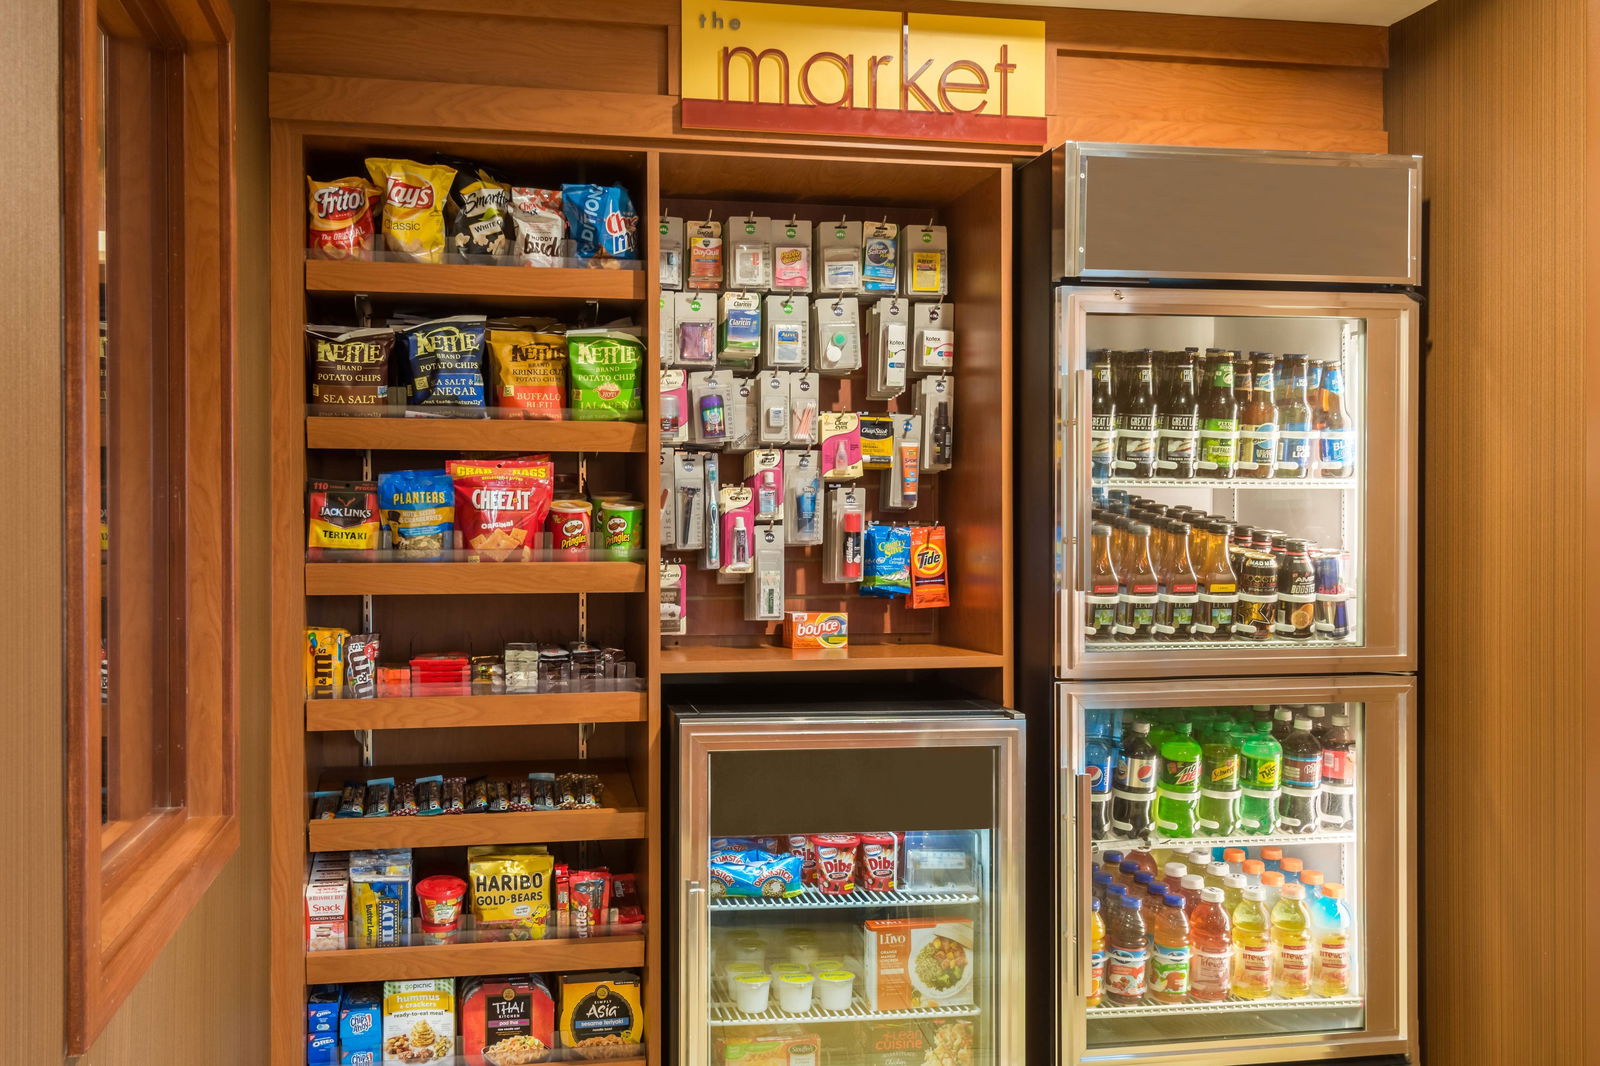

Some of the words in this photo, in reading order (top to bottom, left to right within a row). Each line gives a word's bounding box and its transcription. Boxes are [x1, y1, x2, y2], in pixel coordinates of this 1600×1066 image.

[699, 11, 741, 31] the
[721, 12, 1017, 118] market
[384, 218, 421, 231] Classic
[693, 248, 720, 258] DayQuil
[729, 318, 751, 327] Claritin
[413, 327, 481, 356] KETTLE
[316, 340, 385, 363] KETTLE
[577, 339, 640, 365] KETTLE
[420, 361, 453, 373] POTATO
[454, 361, 479, 369] CHIPS
[512, 368, 548, 376] KRINKLE
[318, 373, 353, 381] POTATO
[355, 374, 382, 382] CHIPS
[444, 378, 466, 386] SALT
[578, 374, 611, 382] POTATO
[323, 394, 345, 404] SEA
[348, 395, 377, 404] SALT
[516, 391, 561, 401] BUFFALO
[834, 419, 849, 427] Clear
[1130, 416, 1147, 426] GREAT
[1172, 416, 1188, 426] GREAT
[861, 426, 888, 435] ChapStick
[313, 482, 329, 490] 110
[393, 491, 446, 505] PLANTERS
[320, 506, 344, 517] JACK
[322, 529, 367, 540] TERIYAKI
[605, 532, 631, 547] Pringles
[561, 533, 587, 550] Pringles
[846, 536, 854, 563] Gillette
[917, 550, 941, 569] Tide
[797, 619, 839, 637] bounce
[823, 859, 853, 873] Dibs
[475, 872, 543, 893] HARIBO
[476, 890, 543, 906] GOLD-BEARS
[312, 903, 341, 912] Snack
[365, 903, 373, 924] Butter
[396, 993, 440, 1003] hummus
[405, 1001, 437, 1009] crackers
[492, 1001, 525, 1014] THAI
[585, 1003, 618, 1018] Asia
[350, 1014, 368, 1027] Chips
[499, 1019, 510, 1027] pad
[603, 1018, 624, 1027] teriyaki
